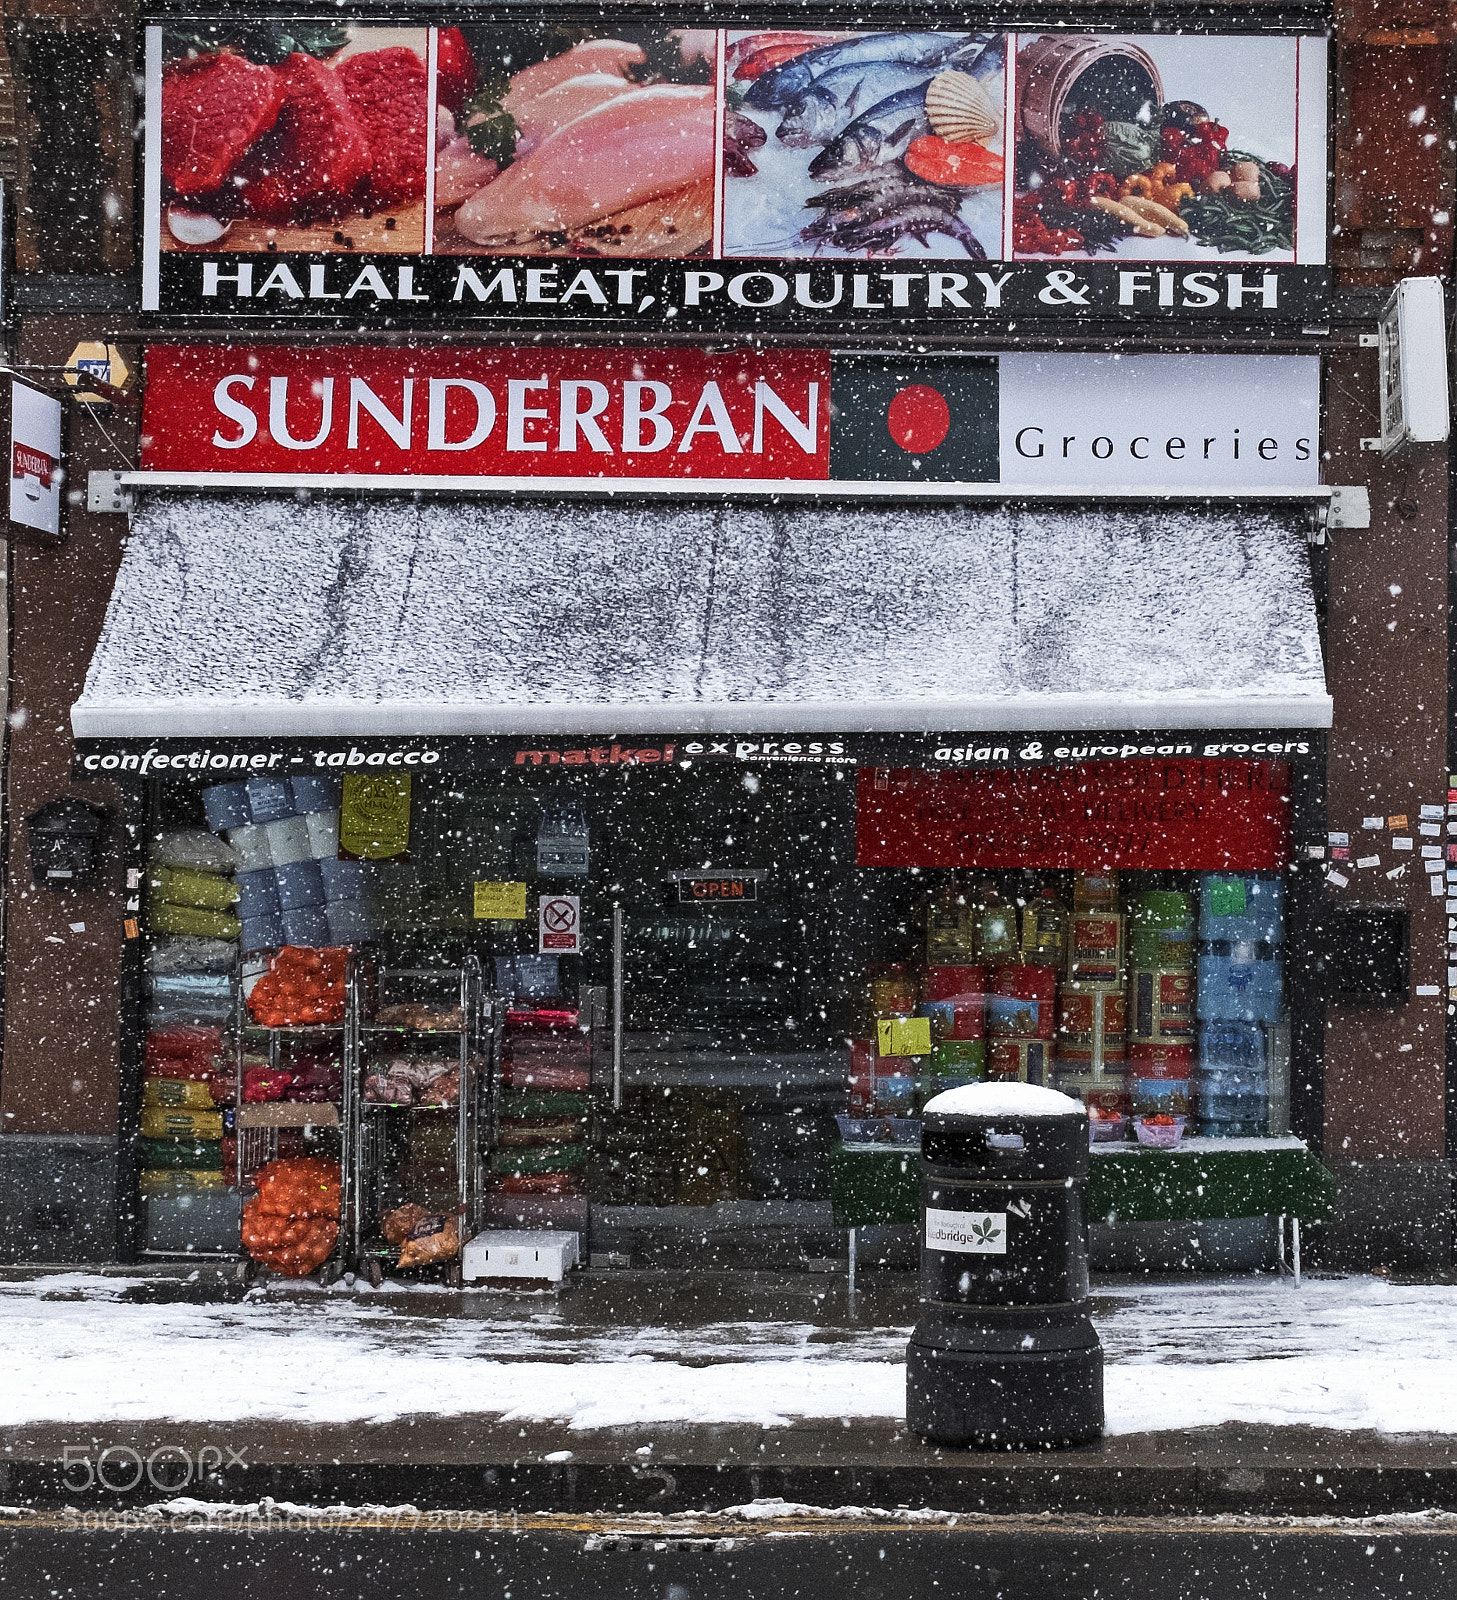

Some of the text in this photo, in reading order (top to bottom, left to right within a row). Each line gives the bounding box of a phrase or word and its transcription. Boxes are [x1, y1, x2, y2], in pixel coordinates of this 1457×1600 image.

[202, 262, 1280, 313] HALAL MEAT, POULTRY & FISH
[211, 373, 819, 456] SUNDERBAN
[1014, 426, 1312, 462] Groceries
[83, 749, 284, 775] confectioner
[312, 747, 440, 767] tabacco
[684, 740, 845, 760] express
[744, 754, 858, 764] convenience store
[934, 739, 1310, 762] asian & european grocers
[692, 881, 744, 897] OPEN
[929, 1229, 974, 1245] dbridge
